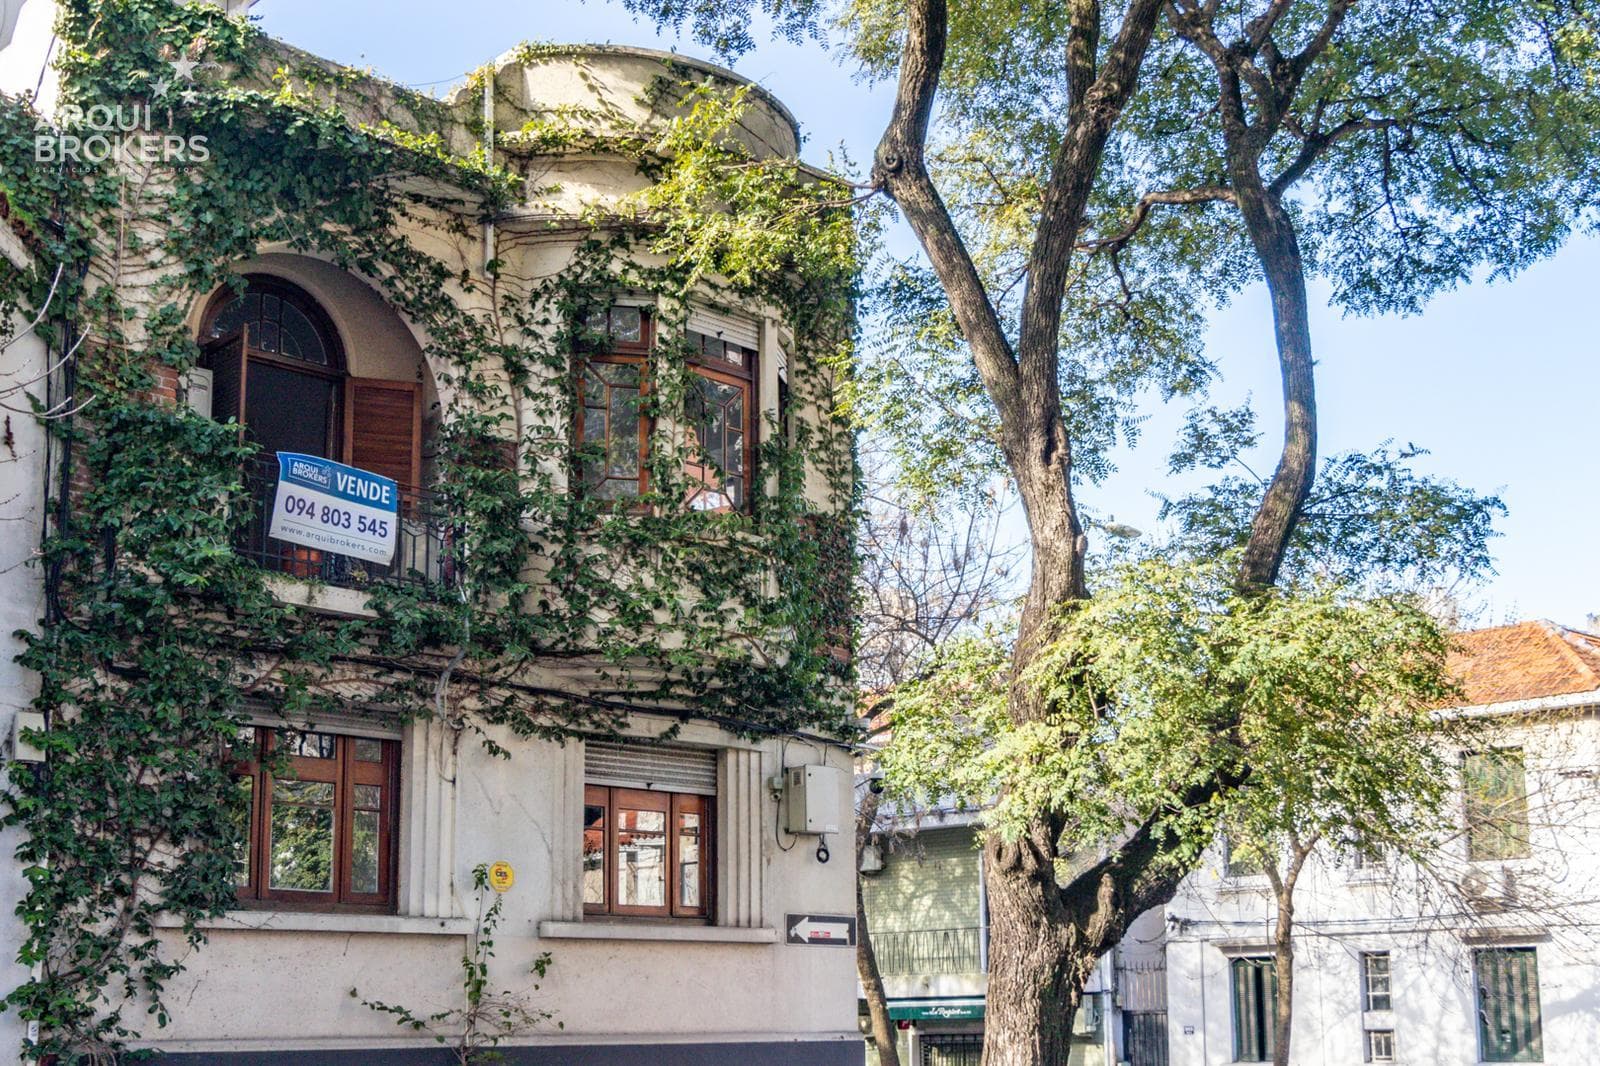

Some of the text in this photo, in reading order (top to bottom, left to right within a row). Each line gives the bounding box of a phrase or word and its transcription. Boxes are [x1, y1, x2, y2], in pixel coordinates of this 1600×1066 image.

[292, 468, 328, 485] BROKERS
[293, 461, 319, 474] ARQUI
[336, 472, 391, 505] VENDE
[285, 495, 388, 539] 094 803 545
[280, 525, 387, 556] www.arquibrokers.com
